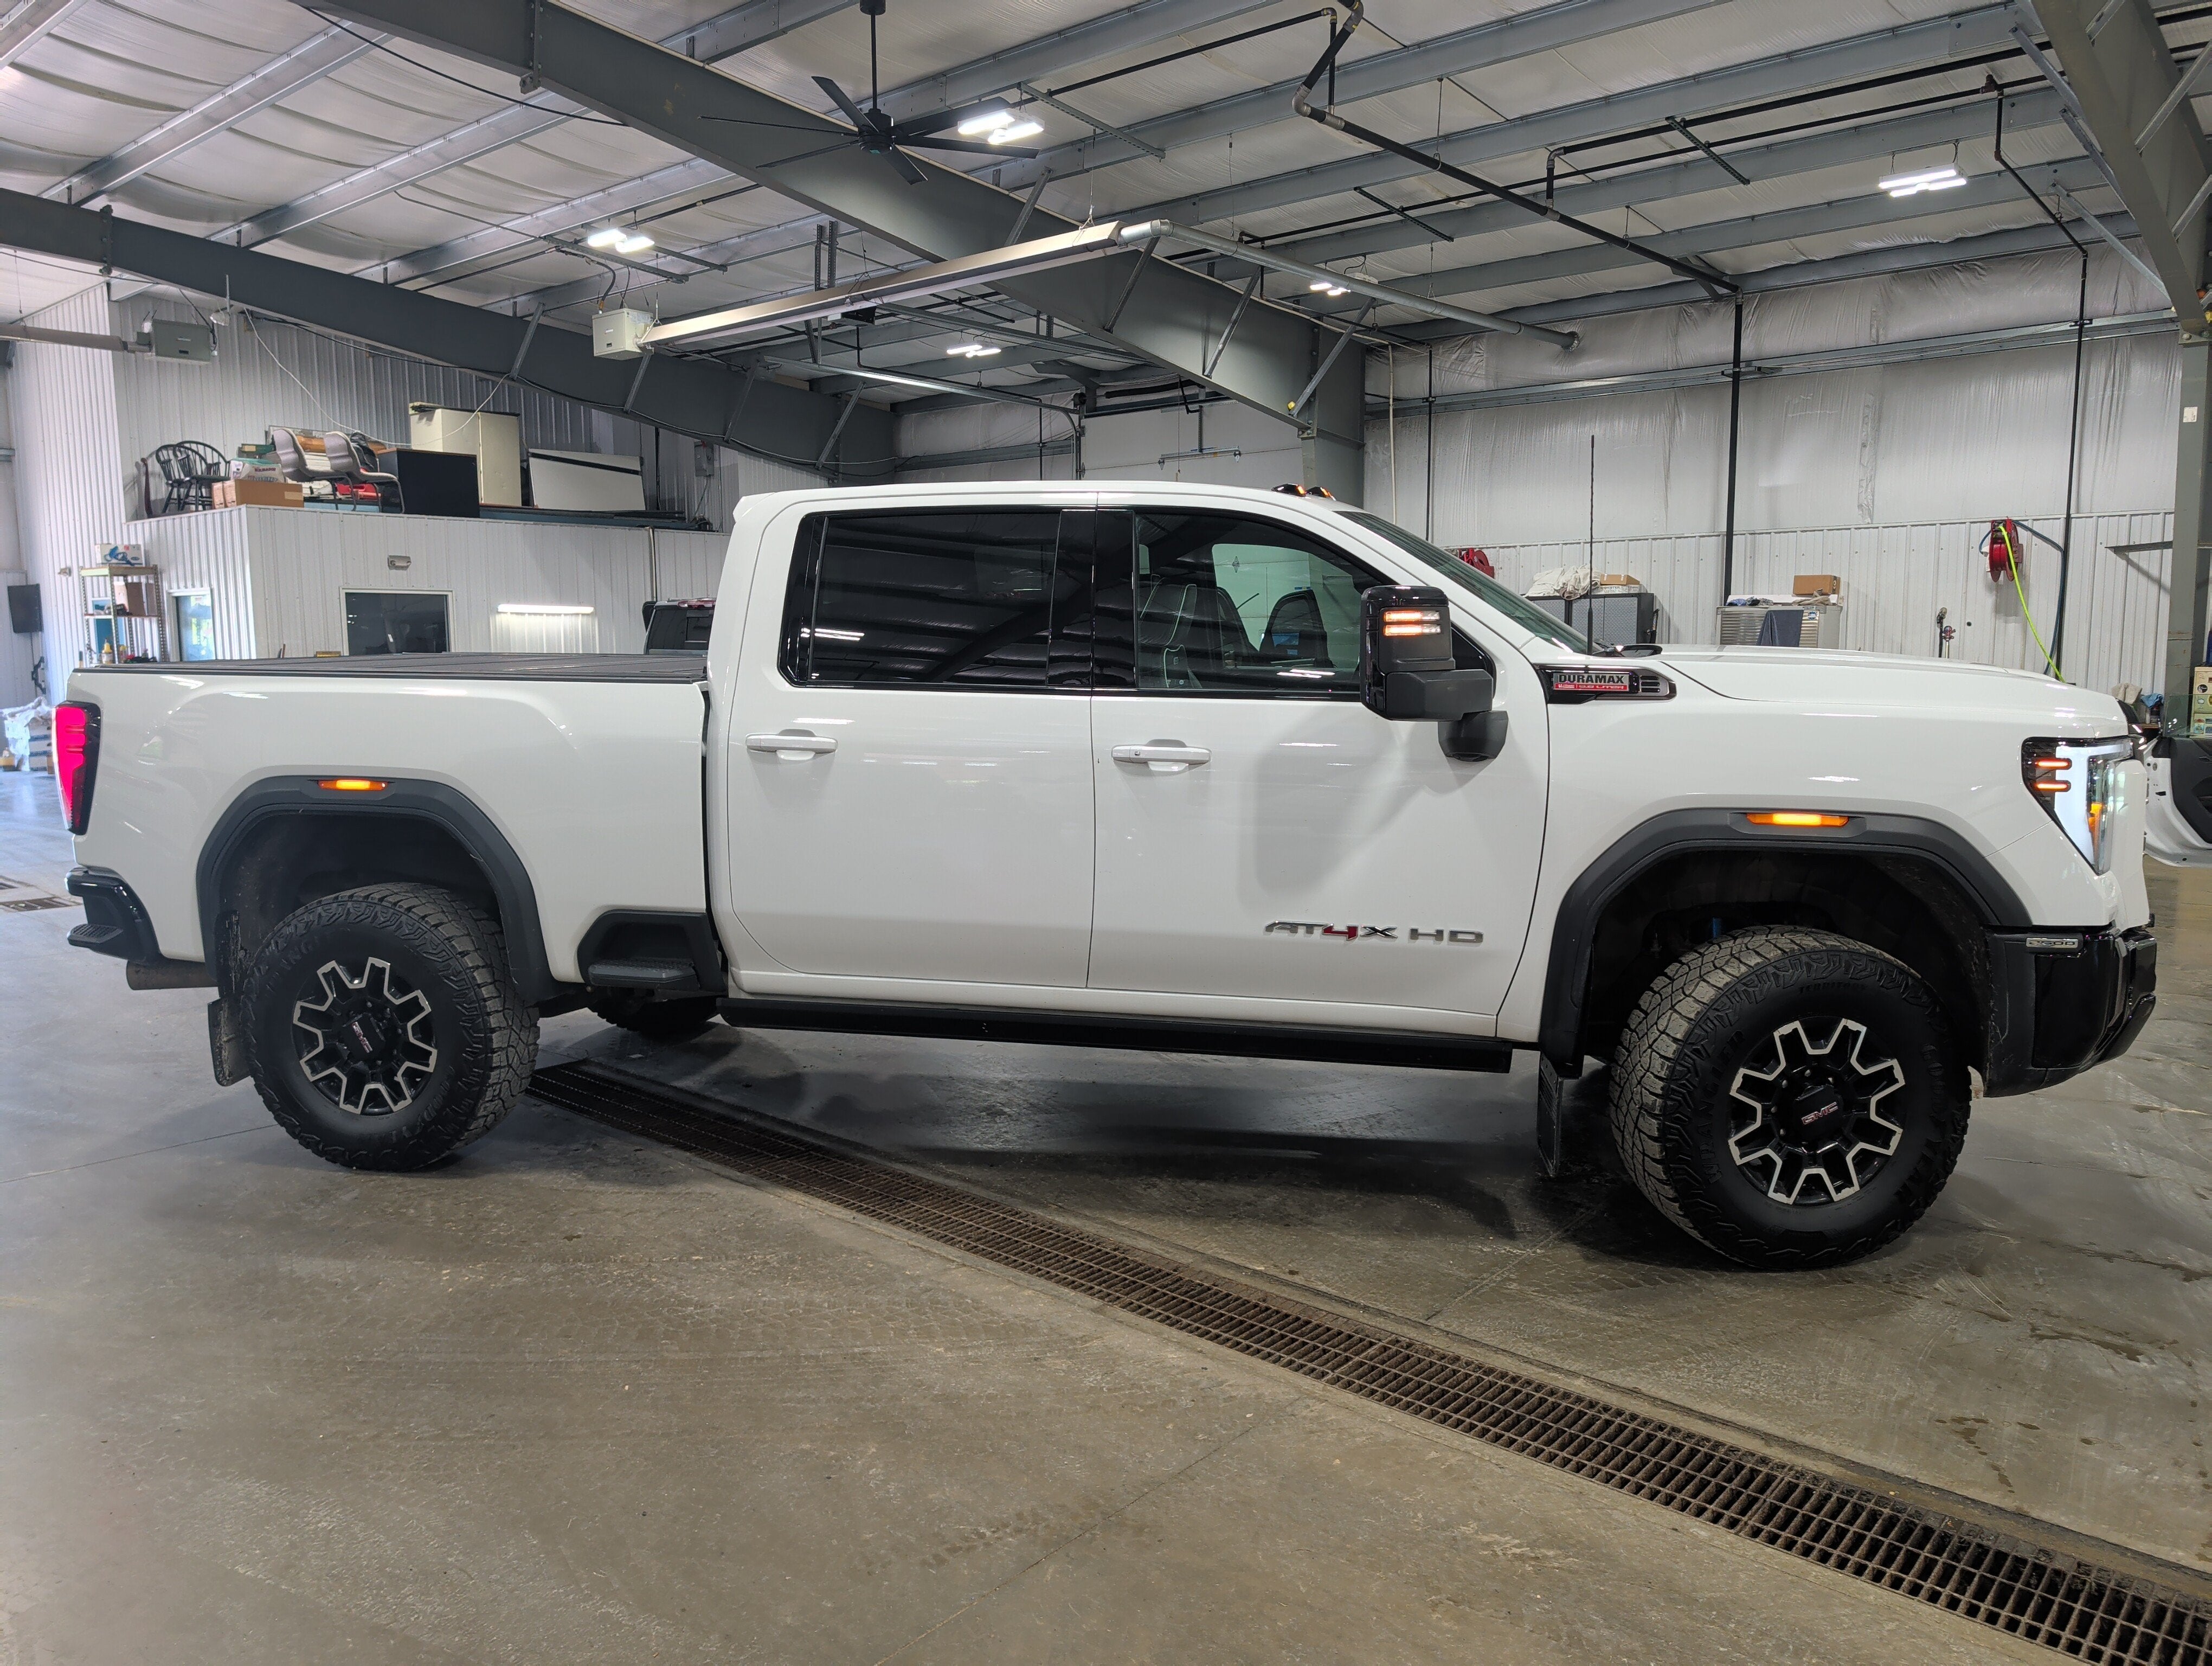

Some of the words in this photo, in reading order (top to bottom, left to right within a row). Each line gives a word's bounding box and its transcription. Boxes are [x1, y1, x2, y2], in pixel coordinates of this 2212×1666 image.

[1558, 674, 1624, 684] DURAMAX
[1265, 920, 1398, 941] AT4X
[1410, 927, 1484, 944] HD
[1802, 1101, 1838, 1125] GMC
